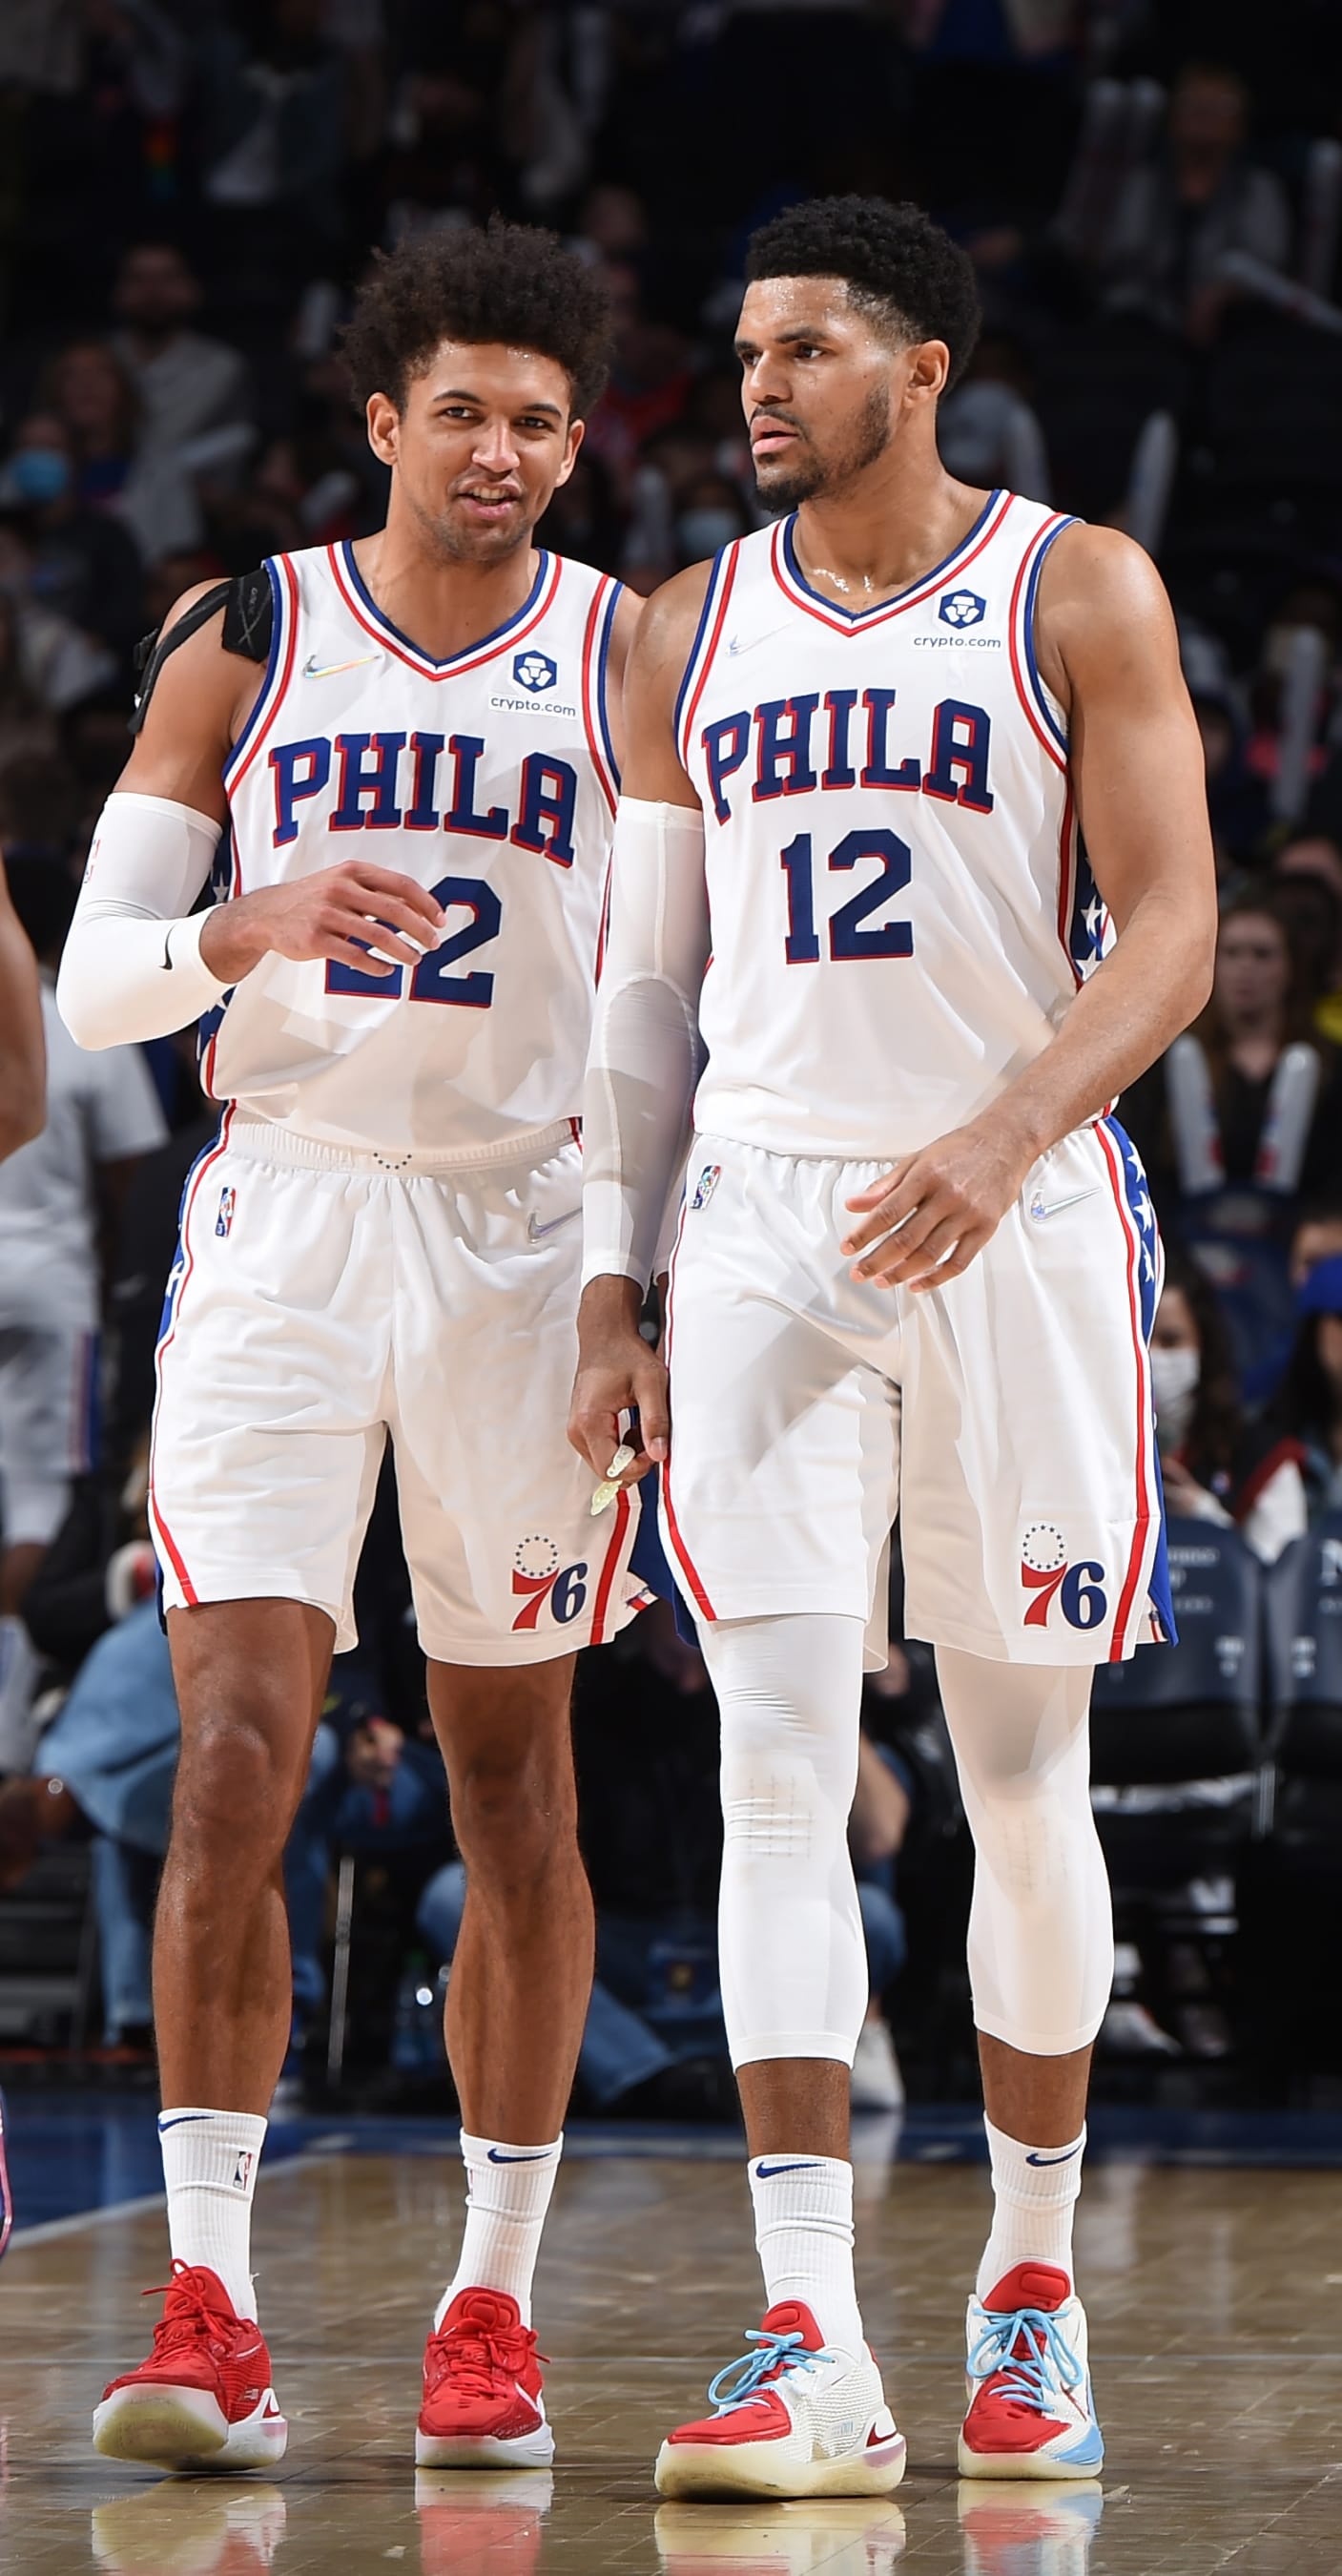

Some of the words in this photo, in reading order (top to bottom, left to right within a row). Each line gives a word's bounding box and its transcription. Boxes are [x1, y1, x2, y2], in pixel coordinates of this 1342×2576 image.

[913, 635, 1001, 649] crypto.com
[490, 696, 576, 717] crypto.com
[701, 688, 995, 826] PHILA
[268, 731, 578, 869] PHILA
[780, 828, 914, 965] 12
[512, 1561, 588, 1631] 76
[1022, 1558, 1107, 1631] 76
